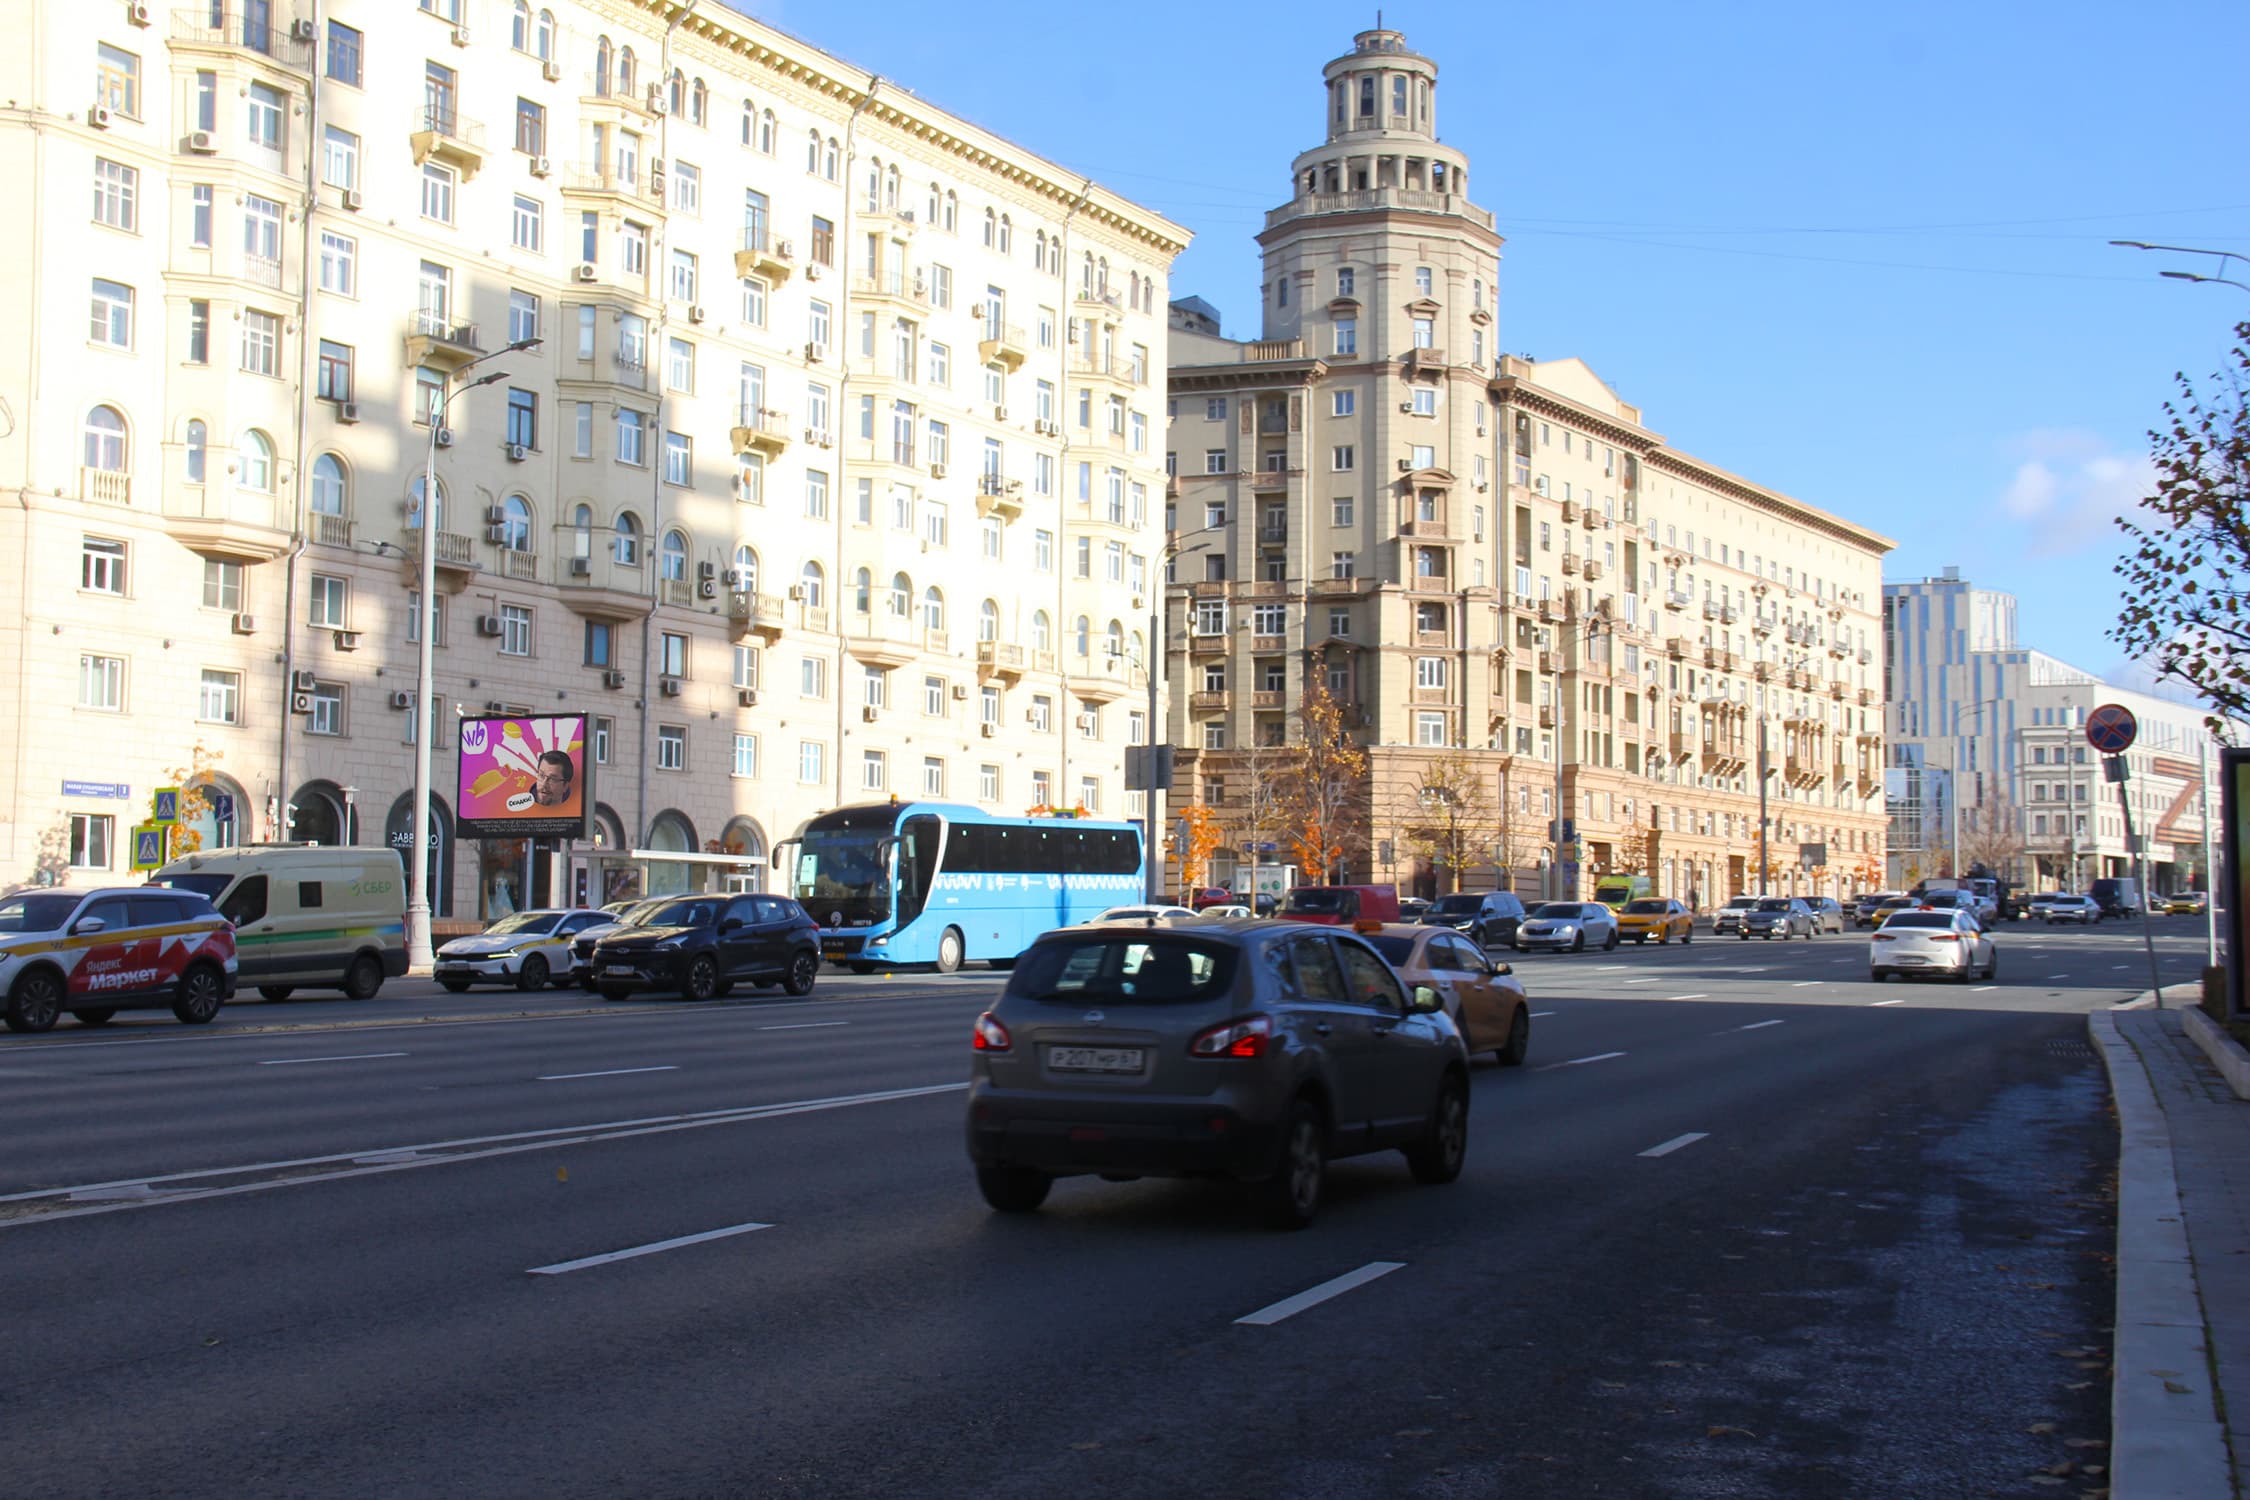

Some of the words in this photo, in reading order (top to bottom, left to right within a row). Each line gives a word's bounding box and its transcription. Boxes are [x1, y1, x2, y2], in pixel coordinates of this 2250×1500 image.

[391, 831, 438, 846] GABBO
[363, 881, 392, 895] СБЕР
[86, 957, 122, 973] Яндекс
[88, 967, 158, 991] Маркет
